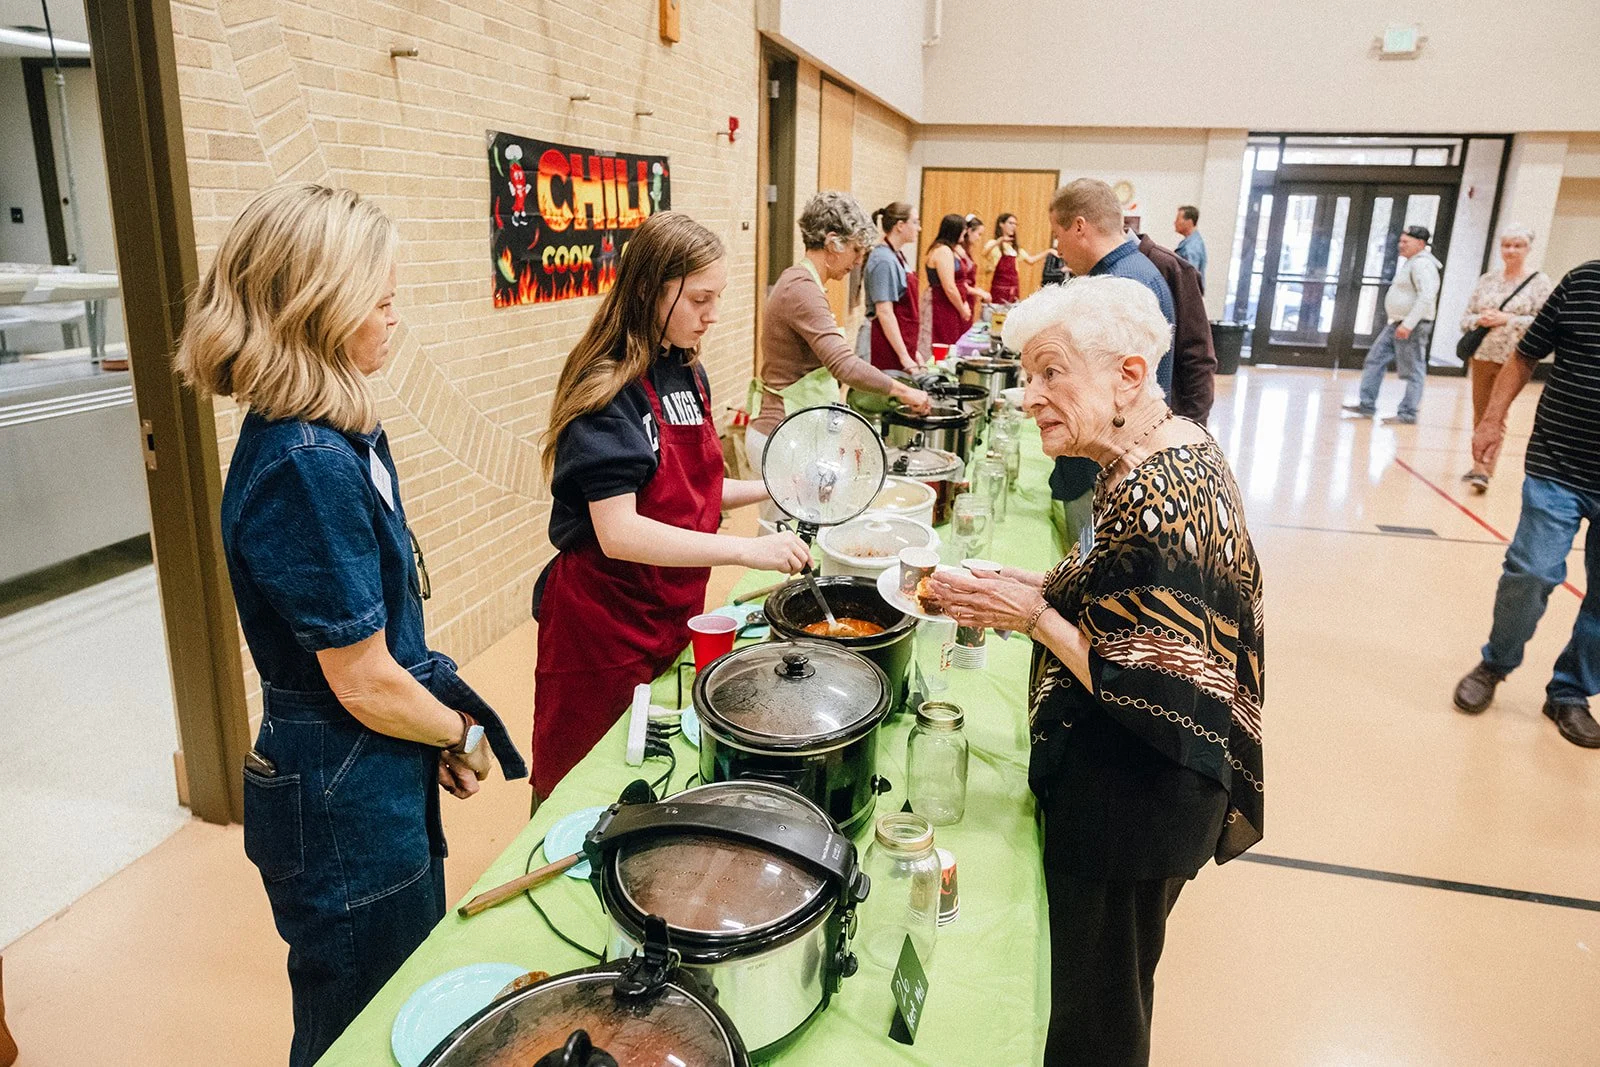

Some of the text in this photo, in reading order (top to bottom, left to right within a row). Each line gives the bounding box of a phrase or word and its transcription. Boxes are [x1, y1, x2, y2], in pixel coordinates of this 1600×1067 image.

[537, 149, 651, 231] CHILI
[541, 244, 594, 275] COOK
[662, 390, 704, 426] ANGE
